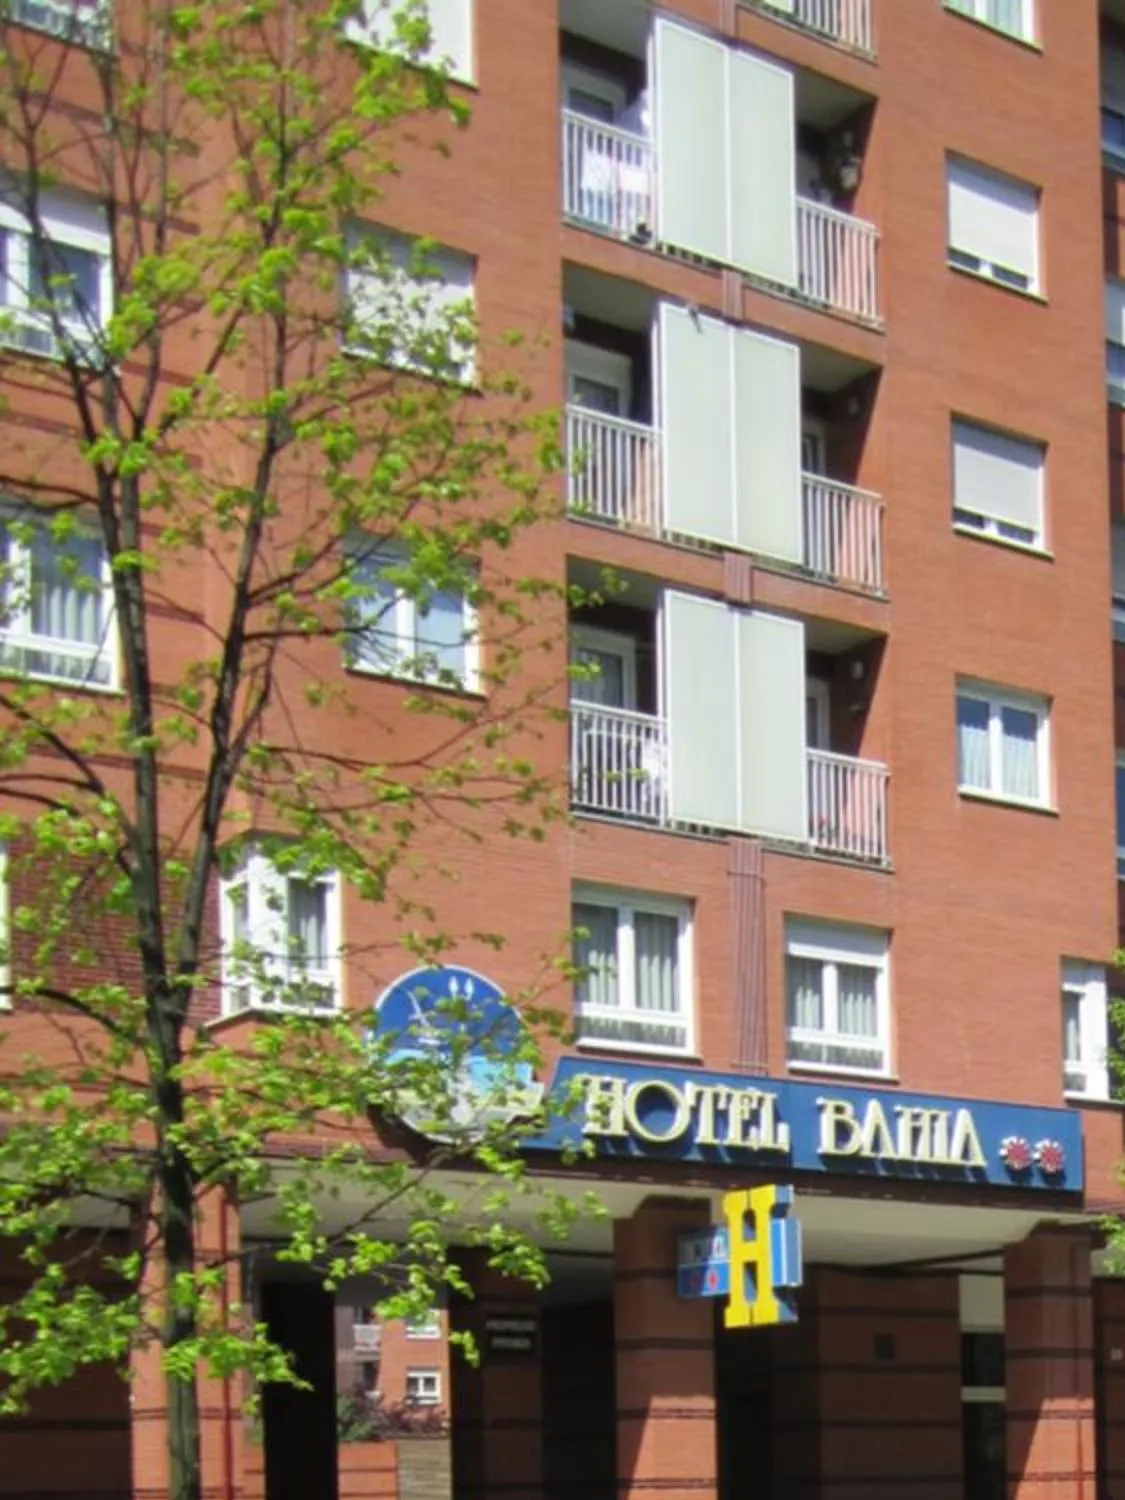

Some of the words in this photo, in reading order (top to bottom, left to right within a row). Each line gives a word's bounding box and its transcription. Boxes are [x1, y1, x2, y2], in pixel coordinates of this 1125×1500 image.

[579, 1074, 789, 1153] HOTEL
[816, 1097, 987, 1167] BAHIA
[722, 1184, 780, 1329] H
